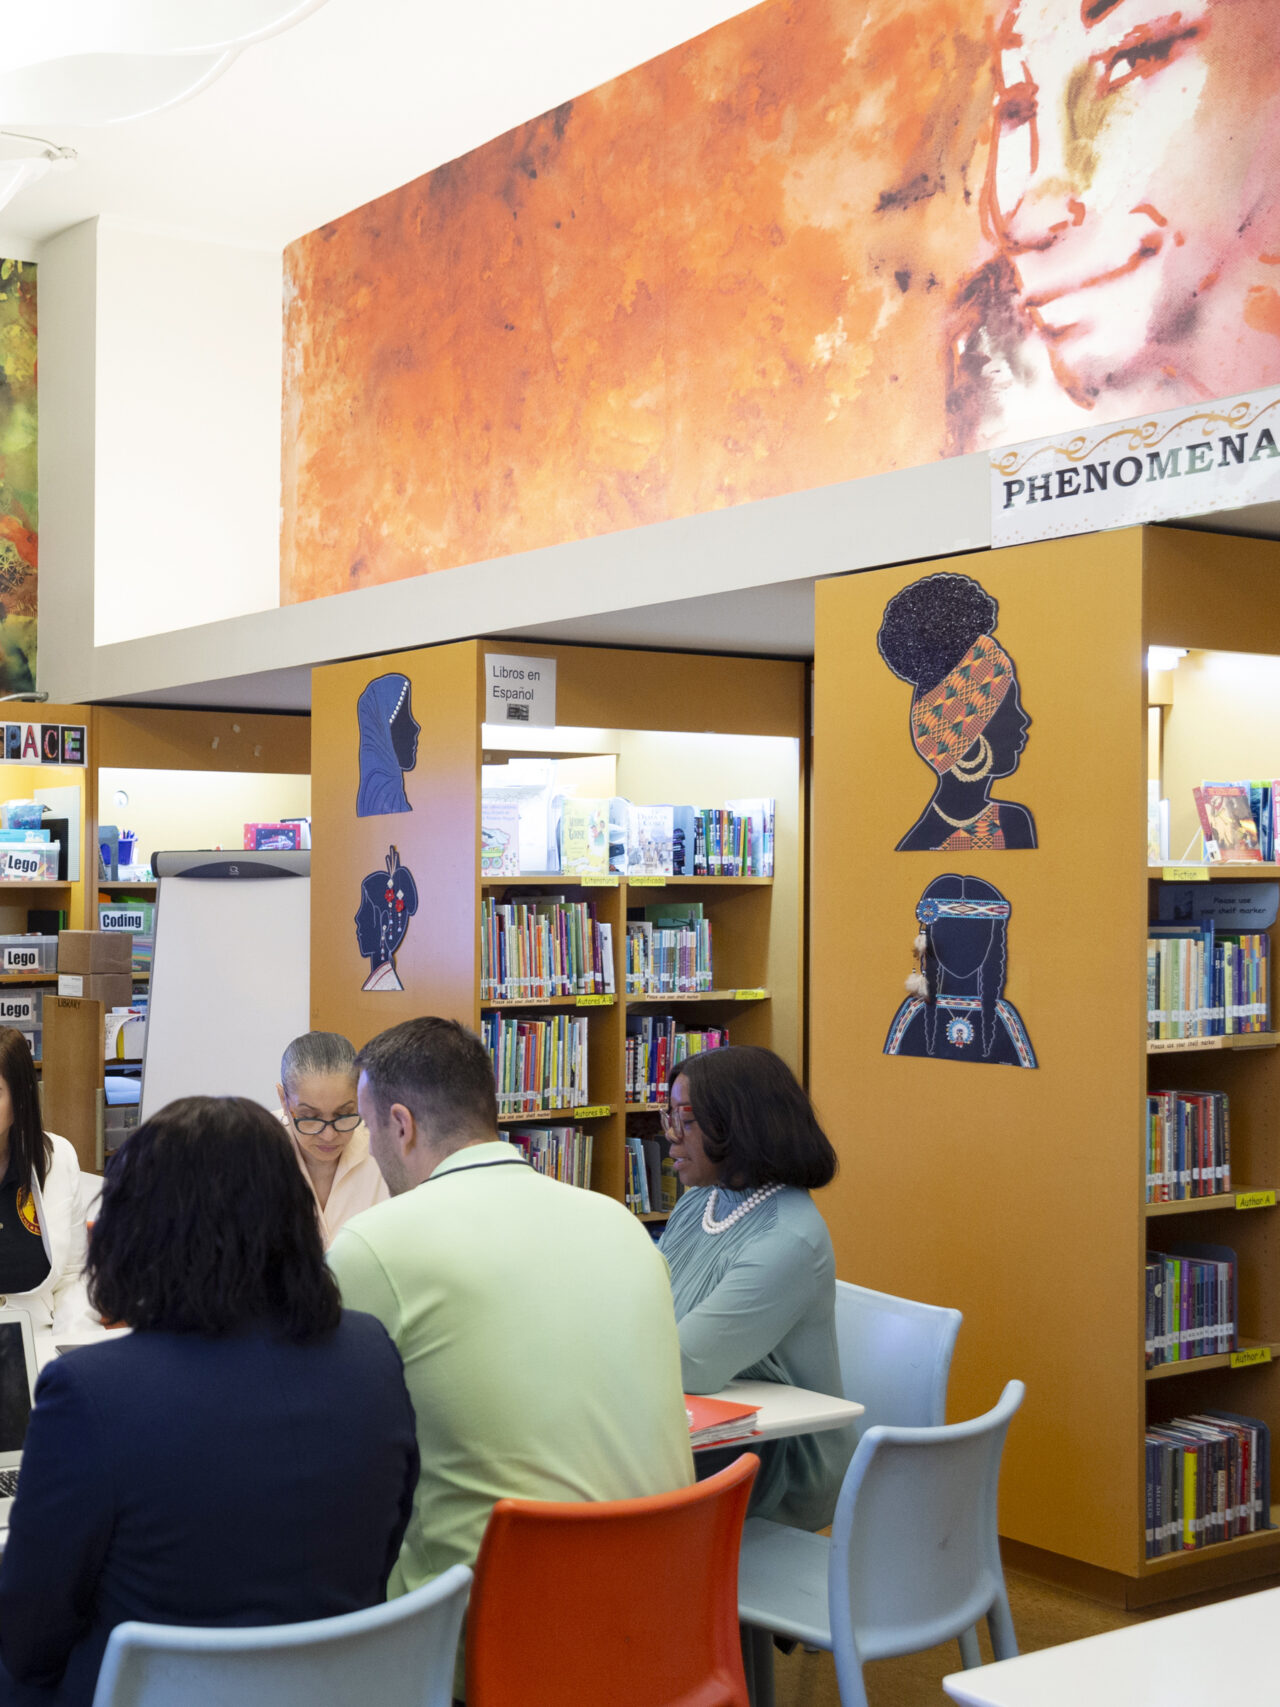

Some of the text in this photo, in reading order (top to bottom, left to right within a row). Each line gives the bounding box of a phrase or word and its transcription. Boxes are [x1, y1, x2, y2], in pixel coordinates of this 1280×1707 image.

[1003, 428, 1280, 509] PHENOMENA
[492, 665, 540, 681] Libros en
[492, 685, 534, 701] Español
[7, 855, 38, 873] Lego
[102, 913, 142, 929] Coding
[7, 950, 36, 967] Lego
[57, 998, 81, 1009] LIBRARY
[577, 996, 600, 1005] Autores
[0, 1002, 30, 1018] Lego
[575, 1109, 598, 1117] Autores
[1239, 1196, 1271, 1207] Author A
[1234, 1352, 1259, 1364] Author
